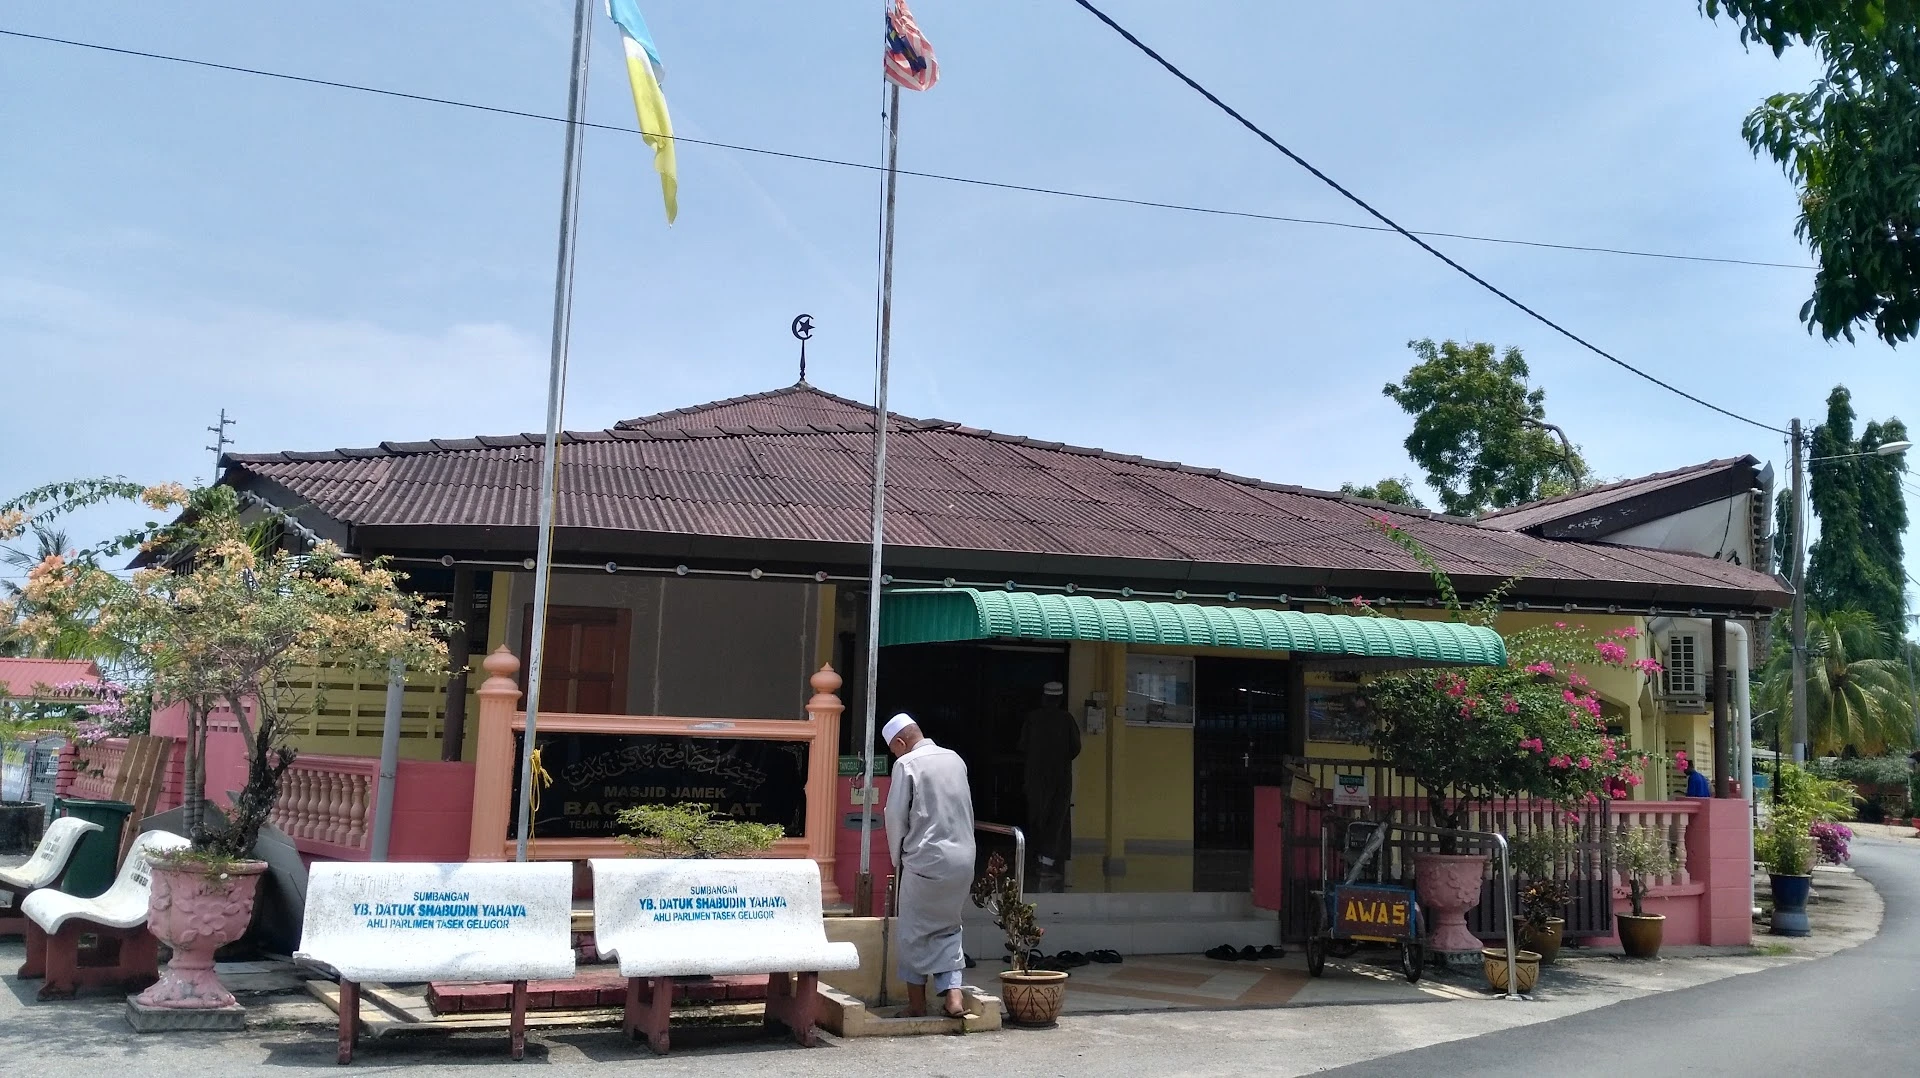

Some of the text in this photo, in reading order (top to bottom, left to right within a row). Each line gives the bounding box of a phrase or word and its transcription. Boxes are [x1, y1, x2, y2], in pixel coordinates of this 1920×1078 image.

[604, 785, 727, 799] MASJID JAMEK
[568, 819, 600, 830] TELUK
[413, 891, 470, 902] SUMBANGAN
[690, 886, 738, 896] SUMBANGAN
[639, 896, 787, 910] YB. DATUK SHABUDIN YAHAYA
[353, 903, 527, 917] YB. DATUK SHABUDIN YAHAYA
[653, 910, 775, 922] AHLI PARLIMEN TASEK GELUGOR
[1345, 901, 1405, 926] AWAS
[366, 918, 510, 929] AHLI PARLIMEN TASEK GELUGOR
